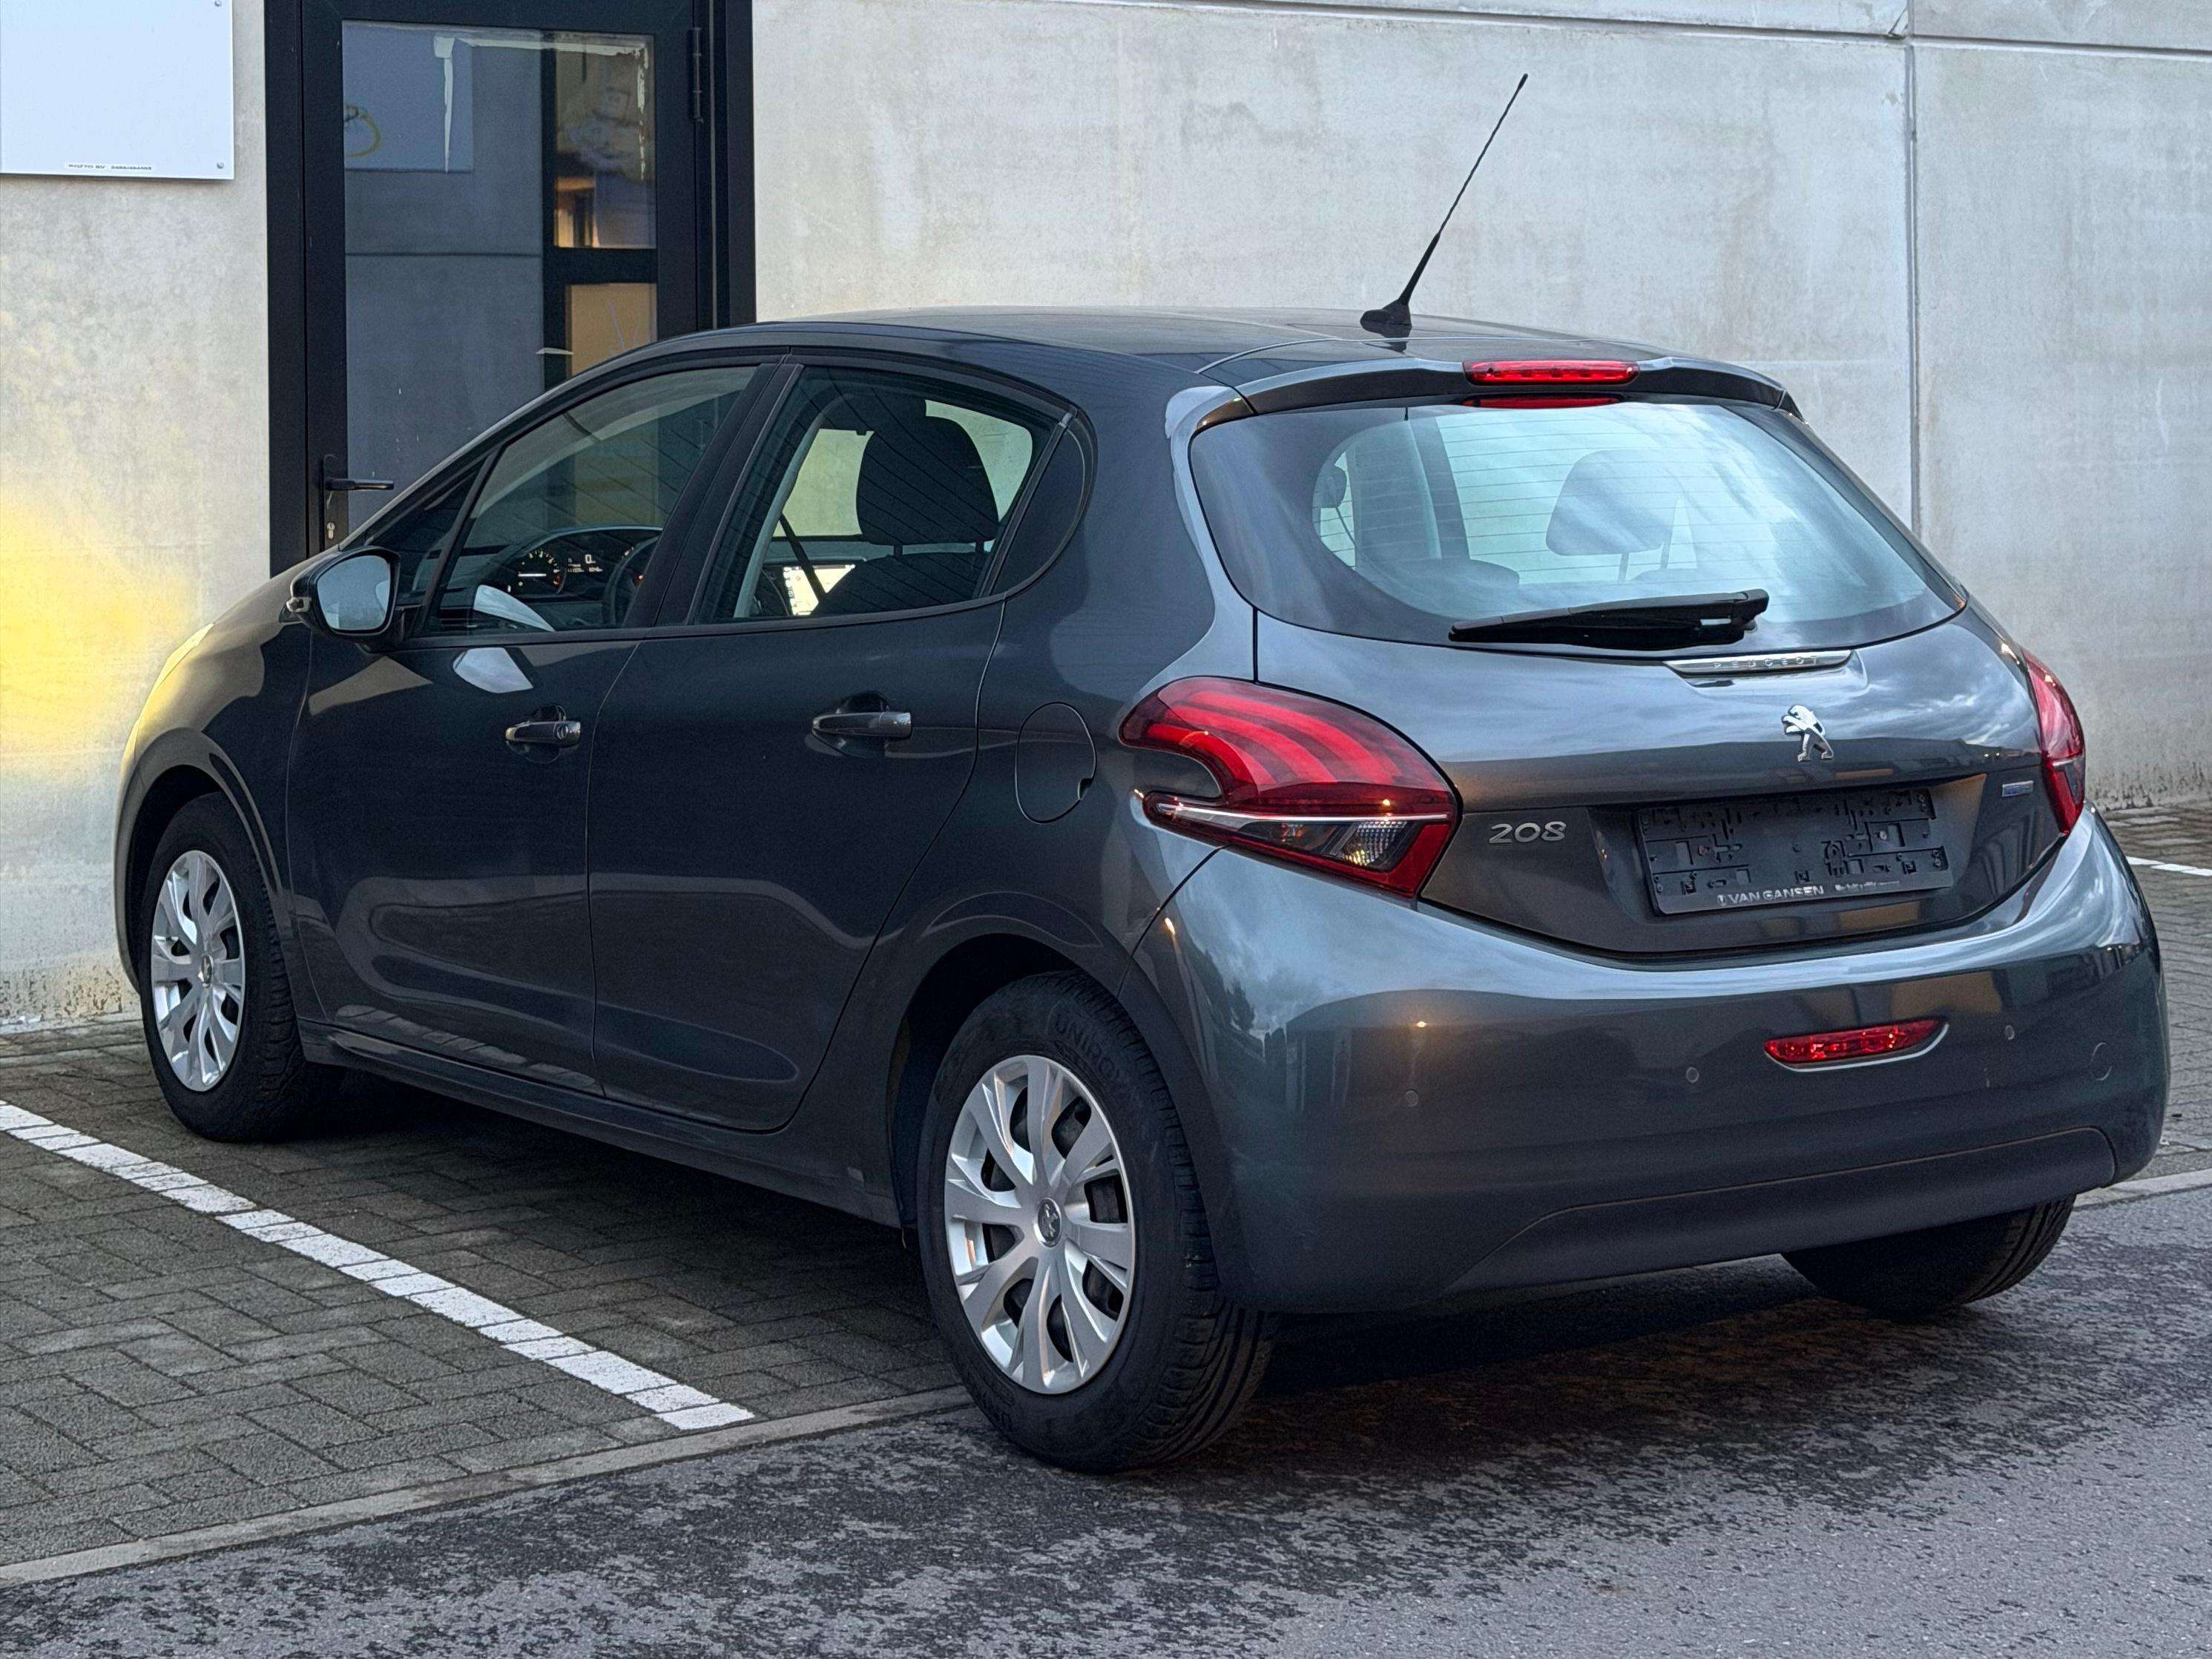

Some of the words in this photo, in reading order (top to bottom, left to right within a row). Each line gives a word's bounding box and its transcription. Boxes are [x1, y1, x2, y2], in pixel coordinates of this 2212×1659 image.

[1712, 656, 1817, 668] PEUGEOT
[1489, 821, 1567, 844] 208
[1728, 892, 1760, 905] VAN
[1762, 885, 1824, 901] GANSEN
